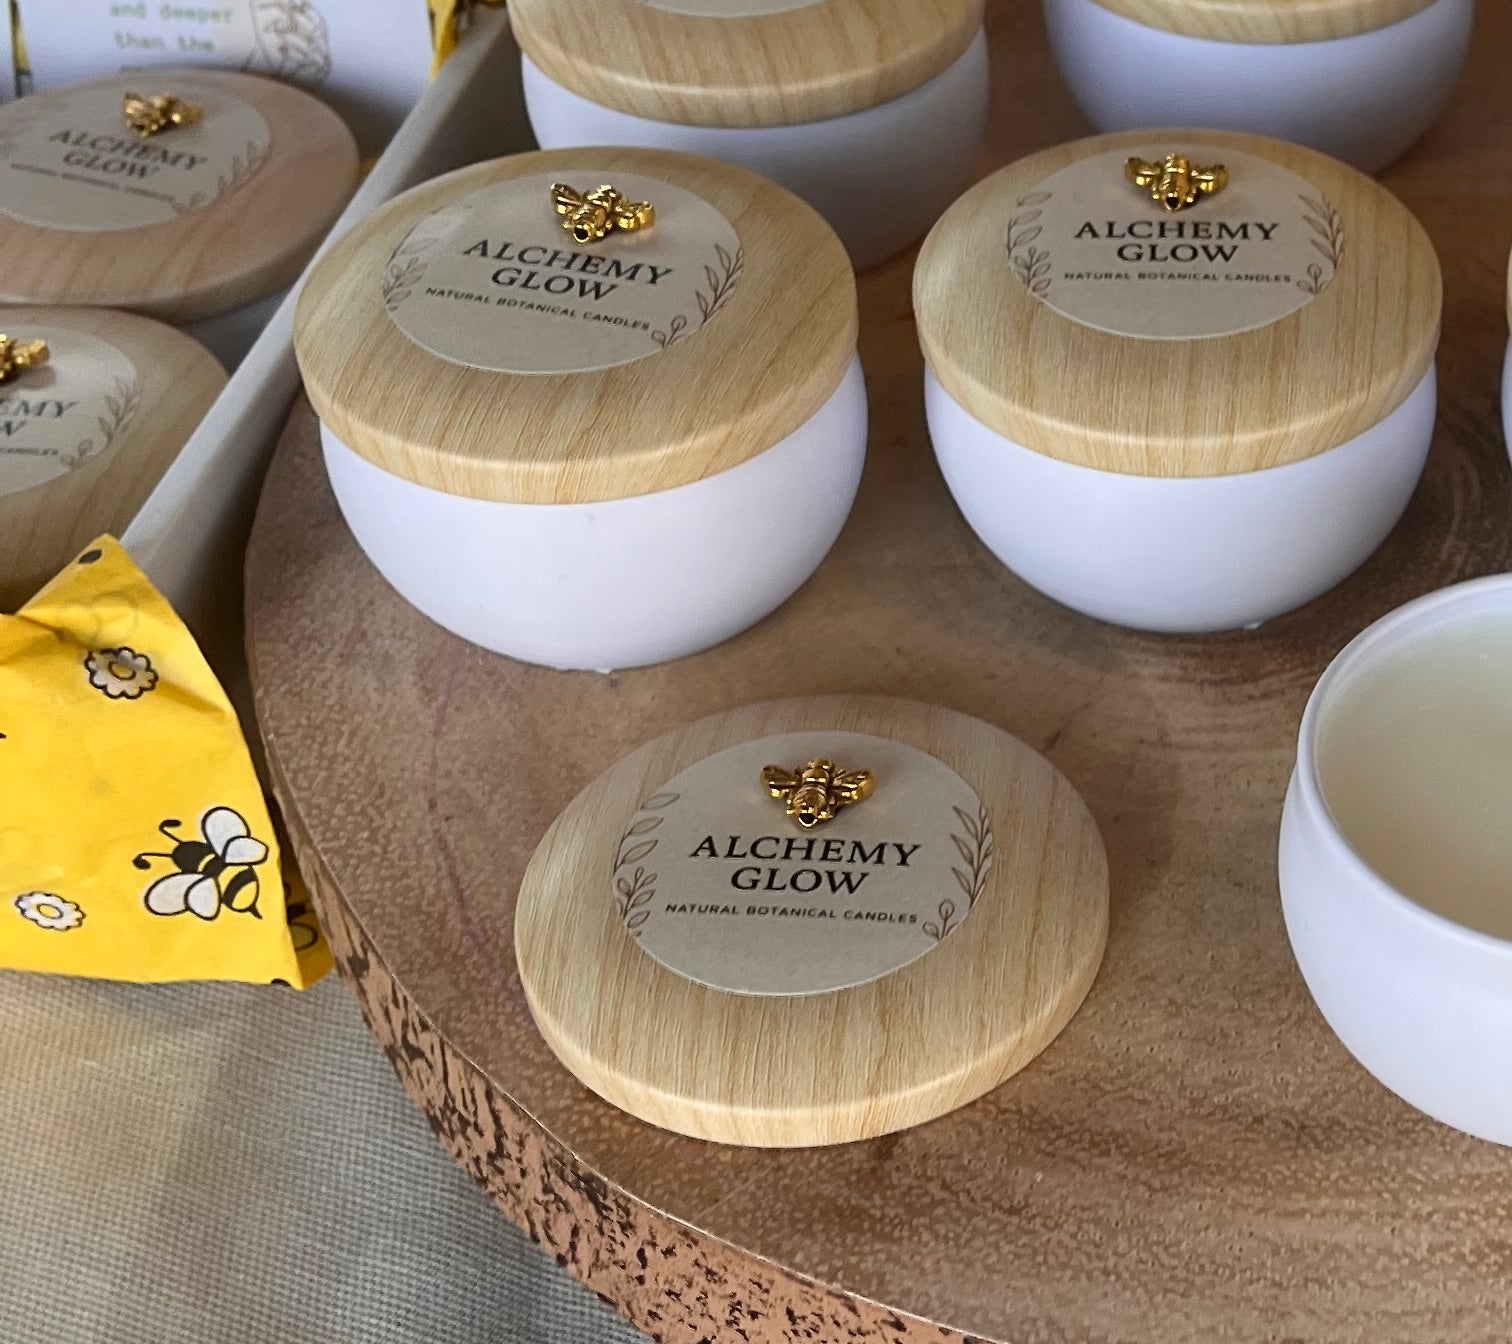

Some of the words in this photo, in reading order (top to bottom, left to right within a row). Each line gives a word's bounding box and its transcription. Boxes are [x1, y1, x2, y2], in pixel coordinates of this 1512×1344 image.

[110, 4, 146, 19] and
[178, 35, 215, 53] the
[49, 129, 209, 171] ALCHEMY
[62, 150, 162, 179] GLOW
[1074, 220, 1281, 241] ALCHEMY
[463, 238, 674, 286] ALCHEMY
[1116, 243, 1240, 264] GLOW
[491, 266, 619, 302] GLOW
[425, 286, 491, 306] NATURAL
[496, 296, 577, 318] BOTANICAL
[582, 311, 651, 330] CANDLES
[689, 834, 921, 869] ALCHEMY
[730, 866, 871, 895] GLOW
[665, 903, 739, 916] NATURAL
[746, 905, 837, 920] BOTANICAL
[843, 909, 918, 925] CANDLES
